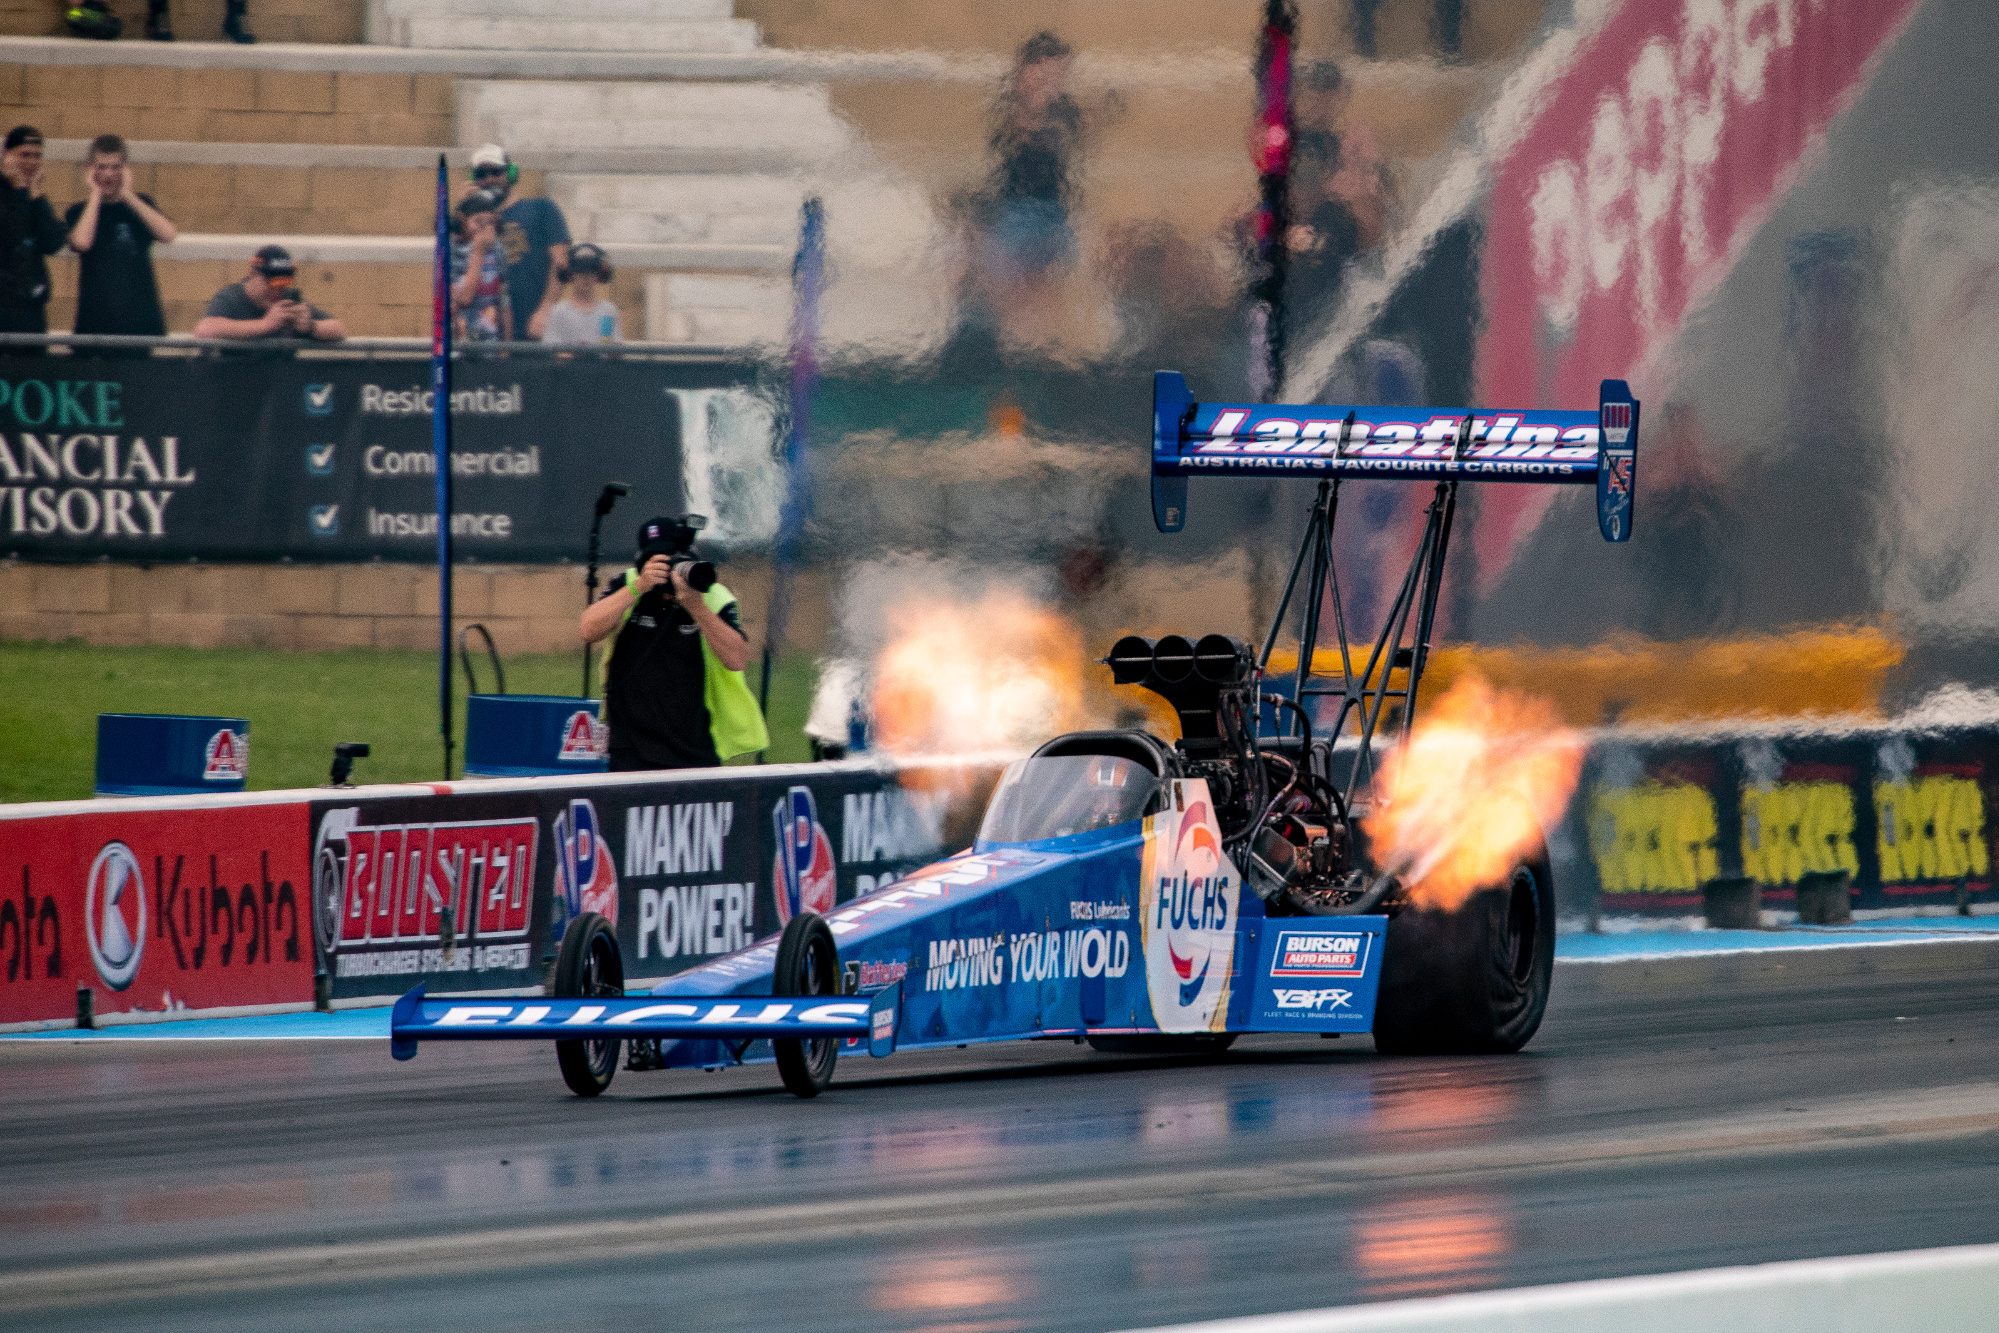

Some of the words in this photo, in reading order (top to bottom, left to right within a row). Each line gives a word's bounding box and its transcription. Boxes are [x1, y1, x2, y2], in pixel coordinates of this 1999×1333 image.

[1194, 410, 1599, 459] Lamattina
[365, 445, 541, 476] Comercial
[1178, 457, 1326, 469] AUSTRALIA'S
[1332, 459, 1459, 472] FAVOURITE
[1464, 462, 1574, 474] CARROTS
[0, 487, 175, 536] ISORY
[367, 506, 512, 538] Insurnce
[624, 801, 734, 876] MAKIN'
[155, 850, 299, 970] Kubota
[637, 882, 756, 958] POWER!
[1157, 876, 1229, 931] FUCHS
[925, 933, 1005, 992] MOVING
[1010, 931, 1061, 983] YOUR
[1064, 929, 1129, 978] WOLD
[1286, 937, 1360, 952] BURSON
[1288, 954, 1317, 964] AUTO
[1318, 954, 1352, 964] PARTS
